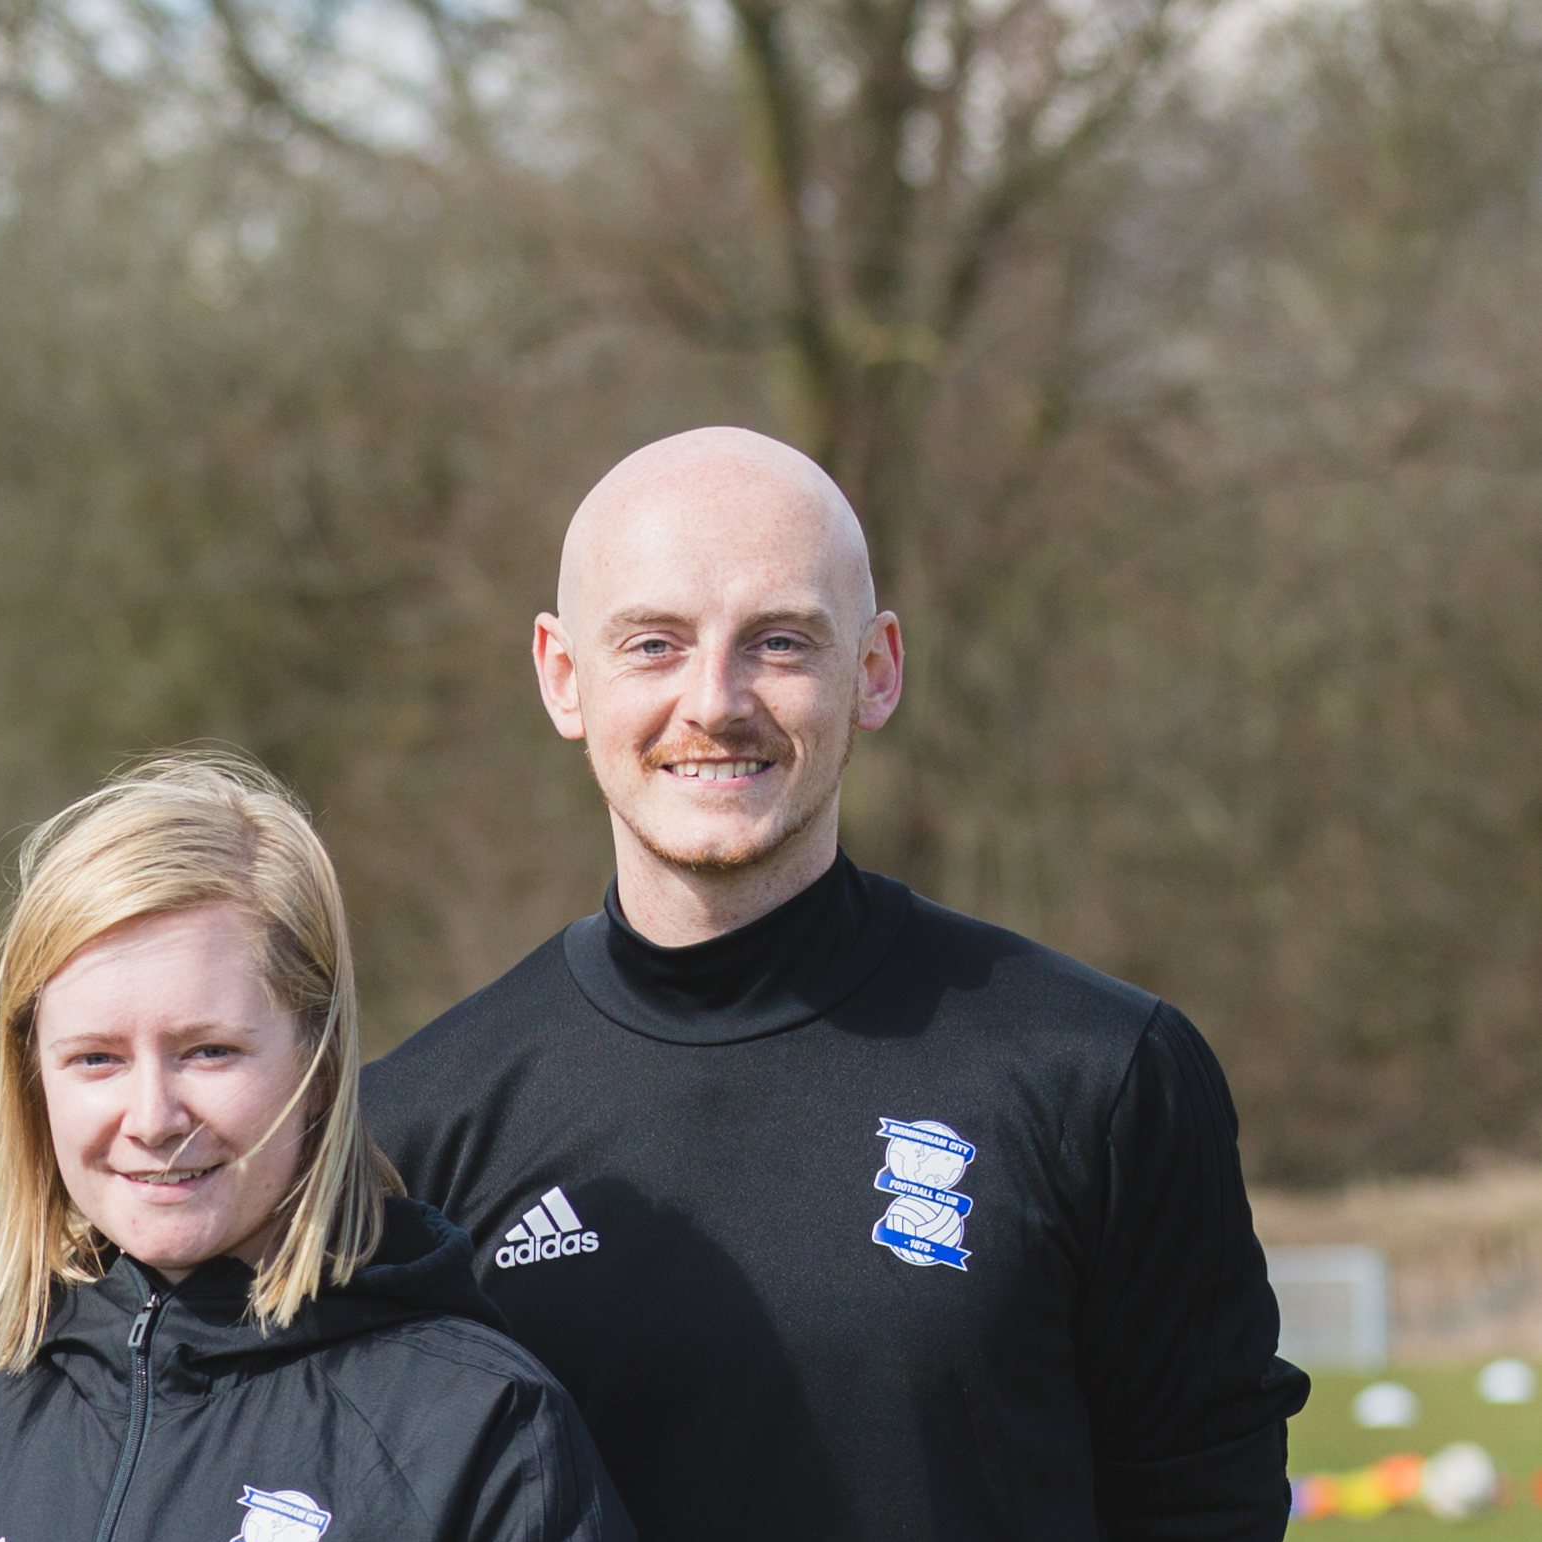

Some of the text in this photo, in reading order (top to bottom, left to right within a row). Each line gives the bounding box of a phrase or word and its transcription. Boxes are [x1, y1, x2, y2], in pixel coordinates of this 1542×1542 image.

[888, 1124, 971, 1155] BIRMINGHAM CITY
[889, 1179, 959, 1206] FOOTBALL CLUB
[495, 1229, 600, 1270] adidas
[305, 1512, 327, 1527] CITY
